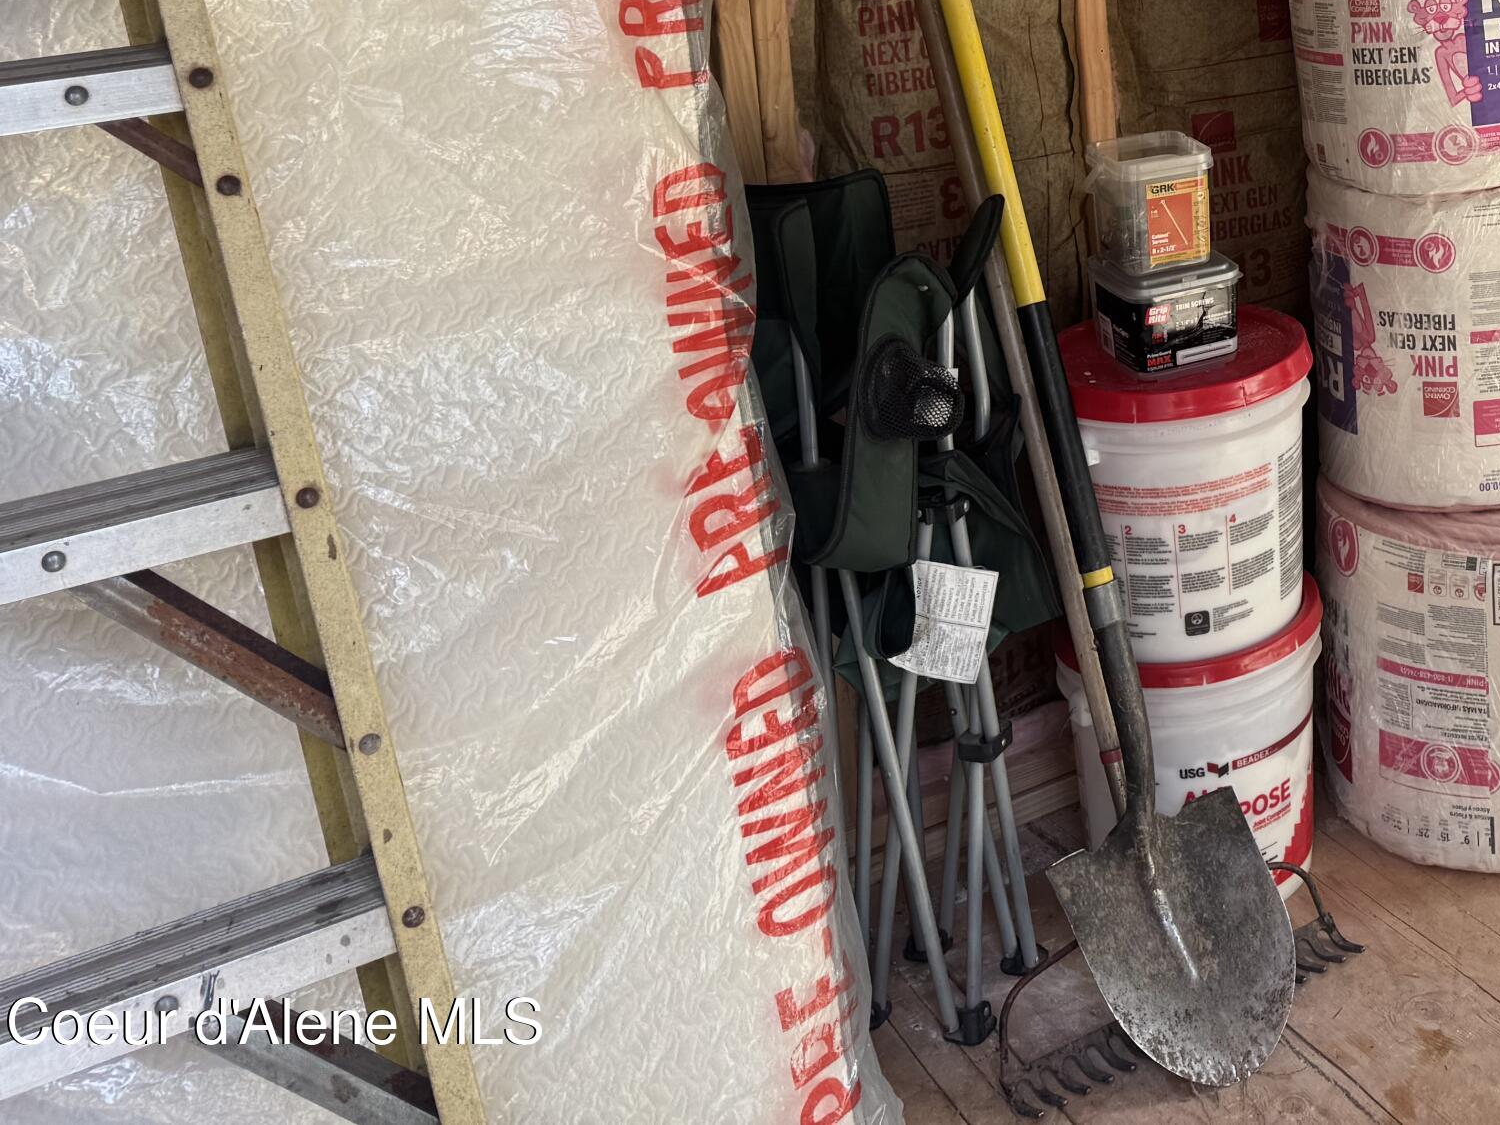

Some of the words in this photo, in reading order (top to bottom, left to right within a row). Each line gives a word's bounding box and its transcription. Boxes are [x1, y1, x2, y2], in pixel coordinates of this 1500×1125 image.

[1351, 22, 1394, 43] PINK
[862, 39, 911, 67] NEXT
[1352, 48, 1383, 64] NEXT
[1389, 46, 1418, 64] GEN
[866, 67, 936, 97] FIBER
[1354, 67, 1432, 86] FIBERGLAS
[1487, 81, 1500, 91] 2x4
[871, 106, 951, 159] R13
[1211, 155, 1254, 188] INK
[1151, 183, 1175, 195] GRK
[1211, 191, 1243, 216] EXT
[1246, 185, 1278, 209] GEN
[1210, 208, 1293, 242] BERGLAS
[1241, 247, 1273, 290] 13
[1379, 311, 1456, 331] FIBERGAS
[1389, 332, 1416, 350] GEN
[1421, 334, 1457, 351] NEXT
[1410, 354, 1458, 378] PINK
[1178, 524, 1187, 534] 3
[1229, 513, 1237, 524] 4
[1124, 525, 1132, 536] 2
[1179, 767, 1206, 780] USG
[1236, 749, 1271, 769] BEADEX
[1240, 778, 1292, 817] POSE
